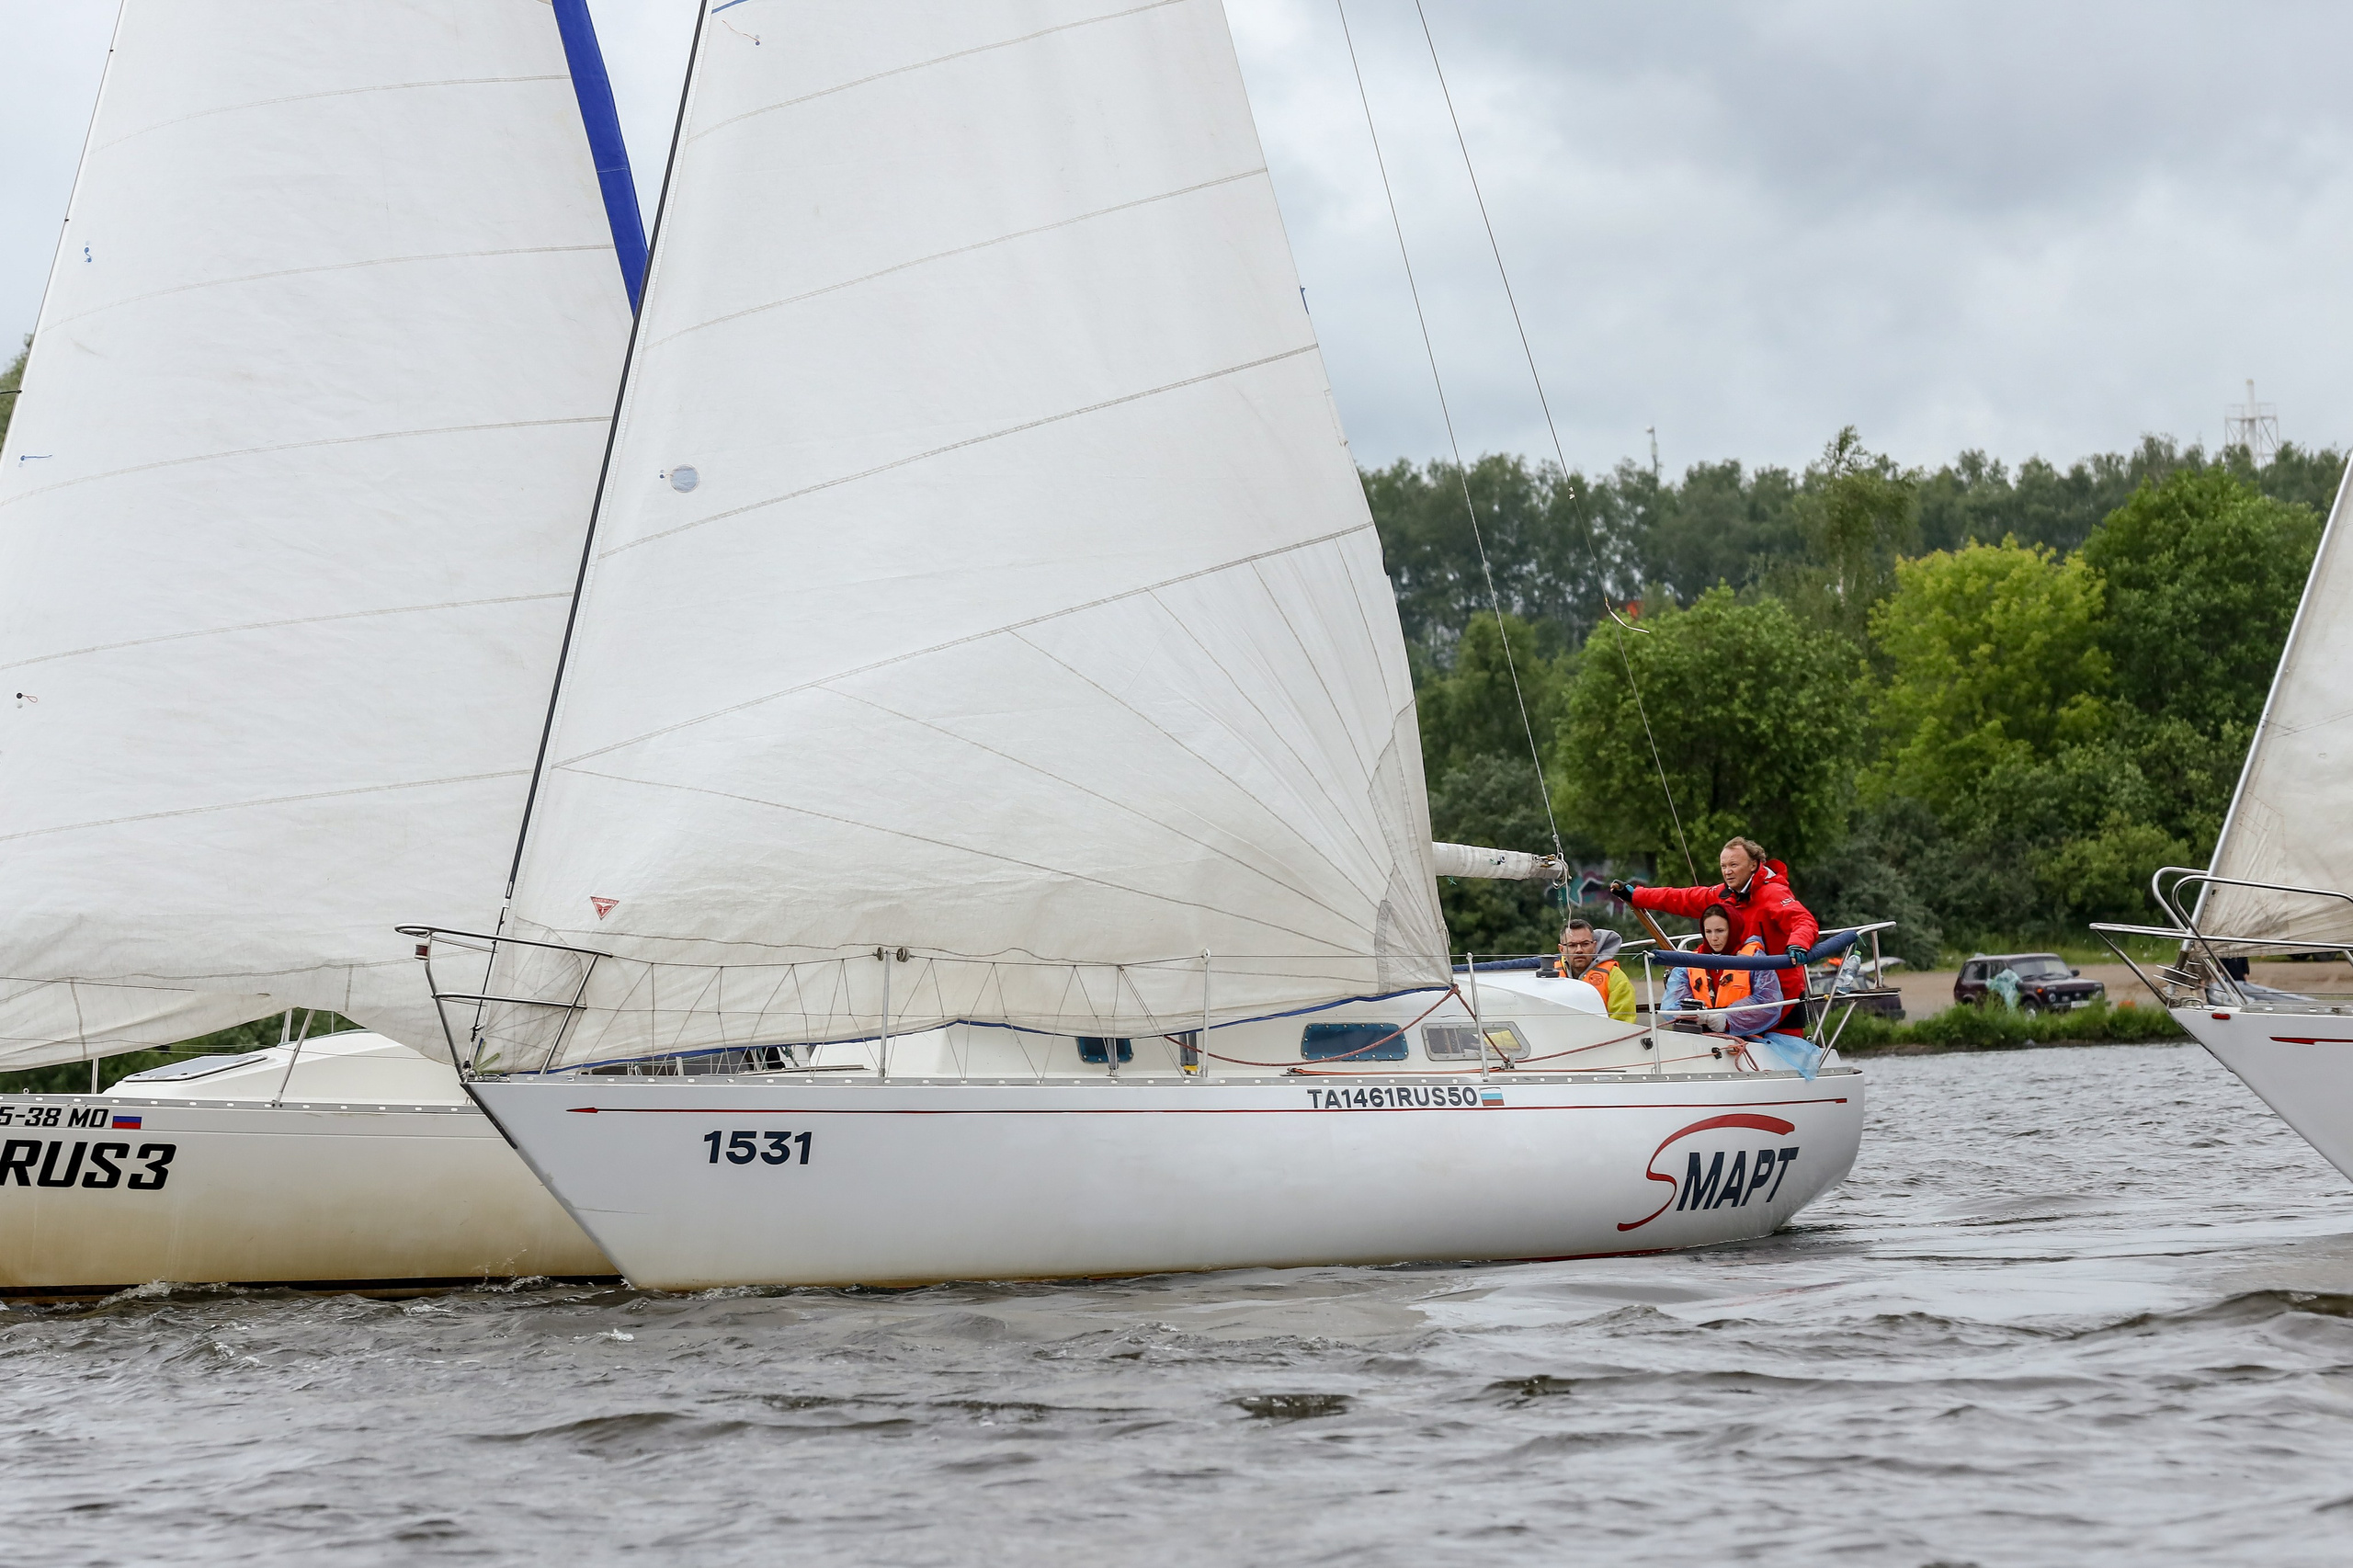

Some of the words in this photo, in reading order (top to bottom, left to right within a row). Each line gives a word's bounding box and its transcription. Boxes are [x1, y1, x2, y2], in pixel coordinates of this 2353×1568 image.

[1307, 1086, 1478, 1109] TA1461RUS50
[0, 1140, 176, 1190] RUS3
[703, 1131, 812, 1165] 1531
